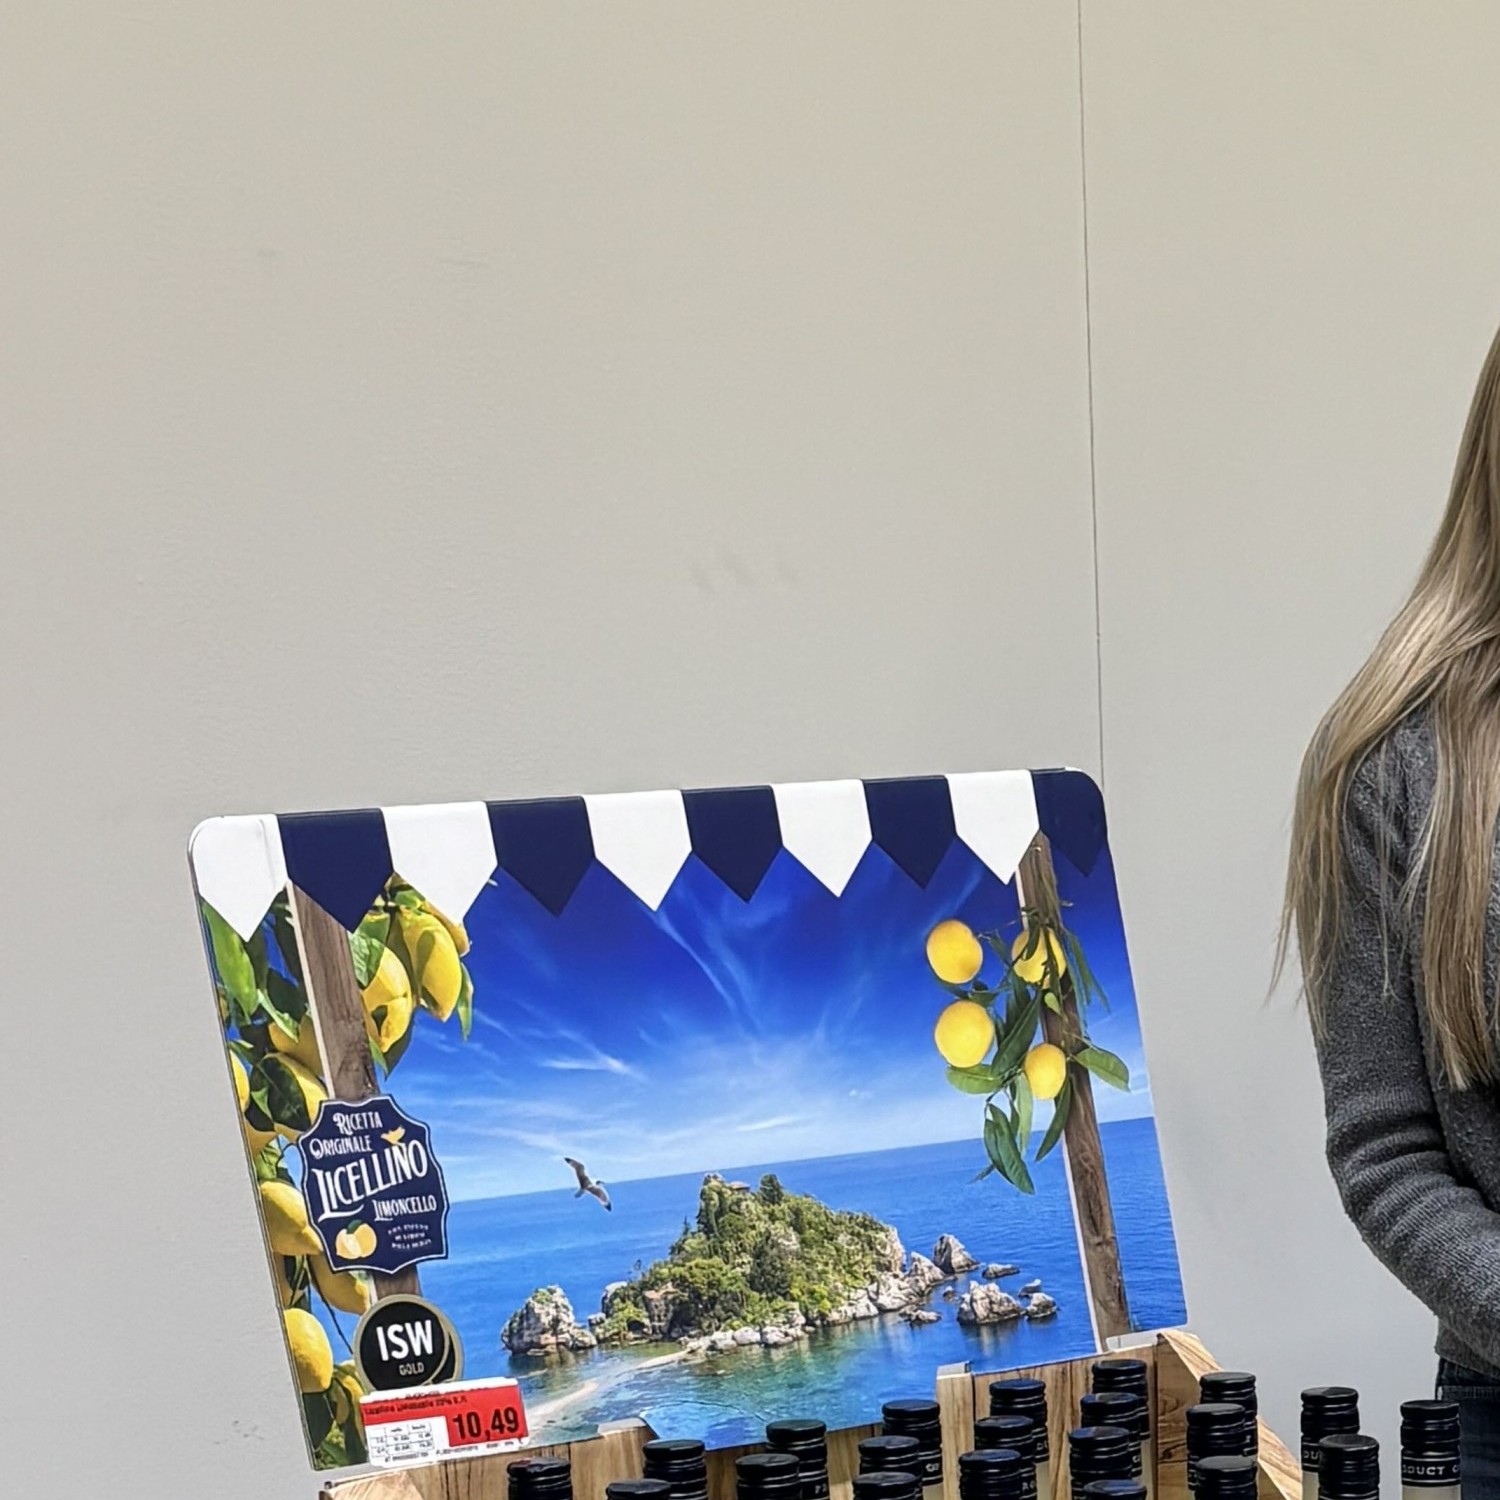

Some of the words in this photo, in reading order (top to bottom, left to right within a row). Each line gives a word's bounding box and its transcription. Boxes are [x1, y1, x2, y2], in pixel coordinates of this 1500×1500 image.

[332, 1111, 383, 1135] RICETTA
[309, 1134, 373, 1160] ORIGINALE
[311, 1139, 428, 1223] LICELLINO
[371, 1194, 438, 1222] LIMONCELLO
[376, 1319, 434, 1362] ISW
[398, 1362, 425, 1376] GOLD
[452, 1406, 520, 1442] 10,49
